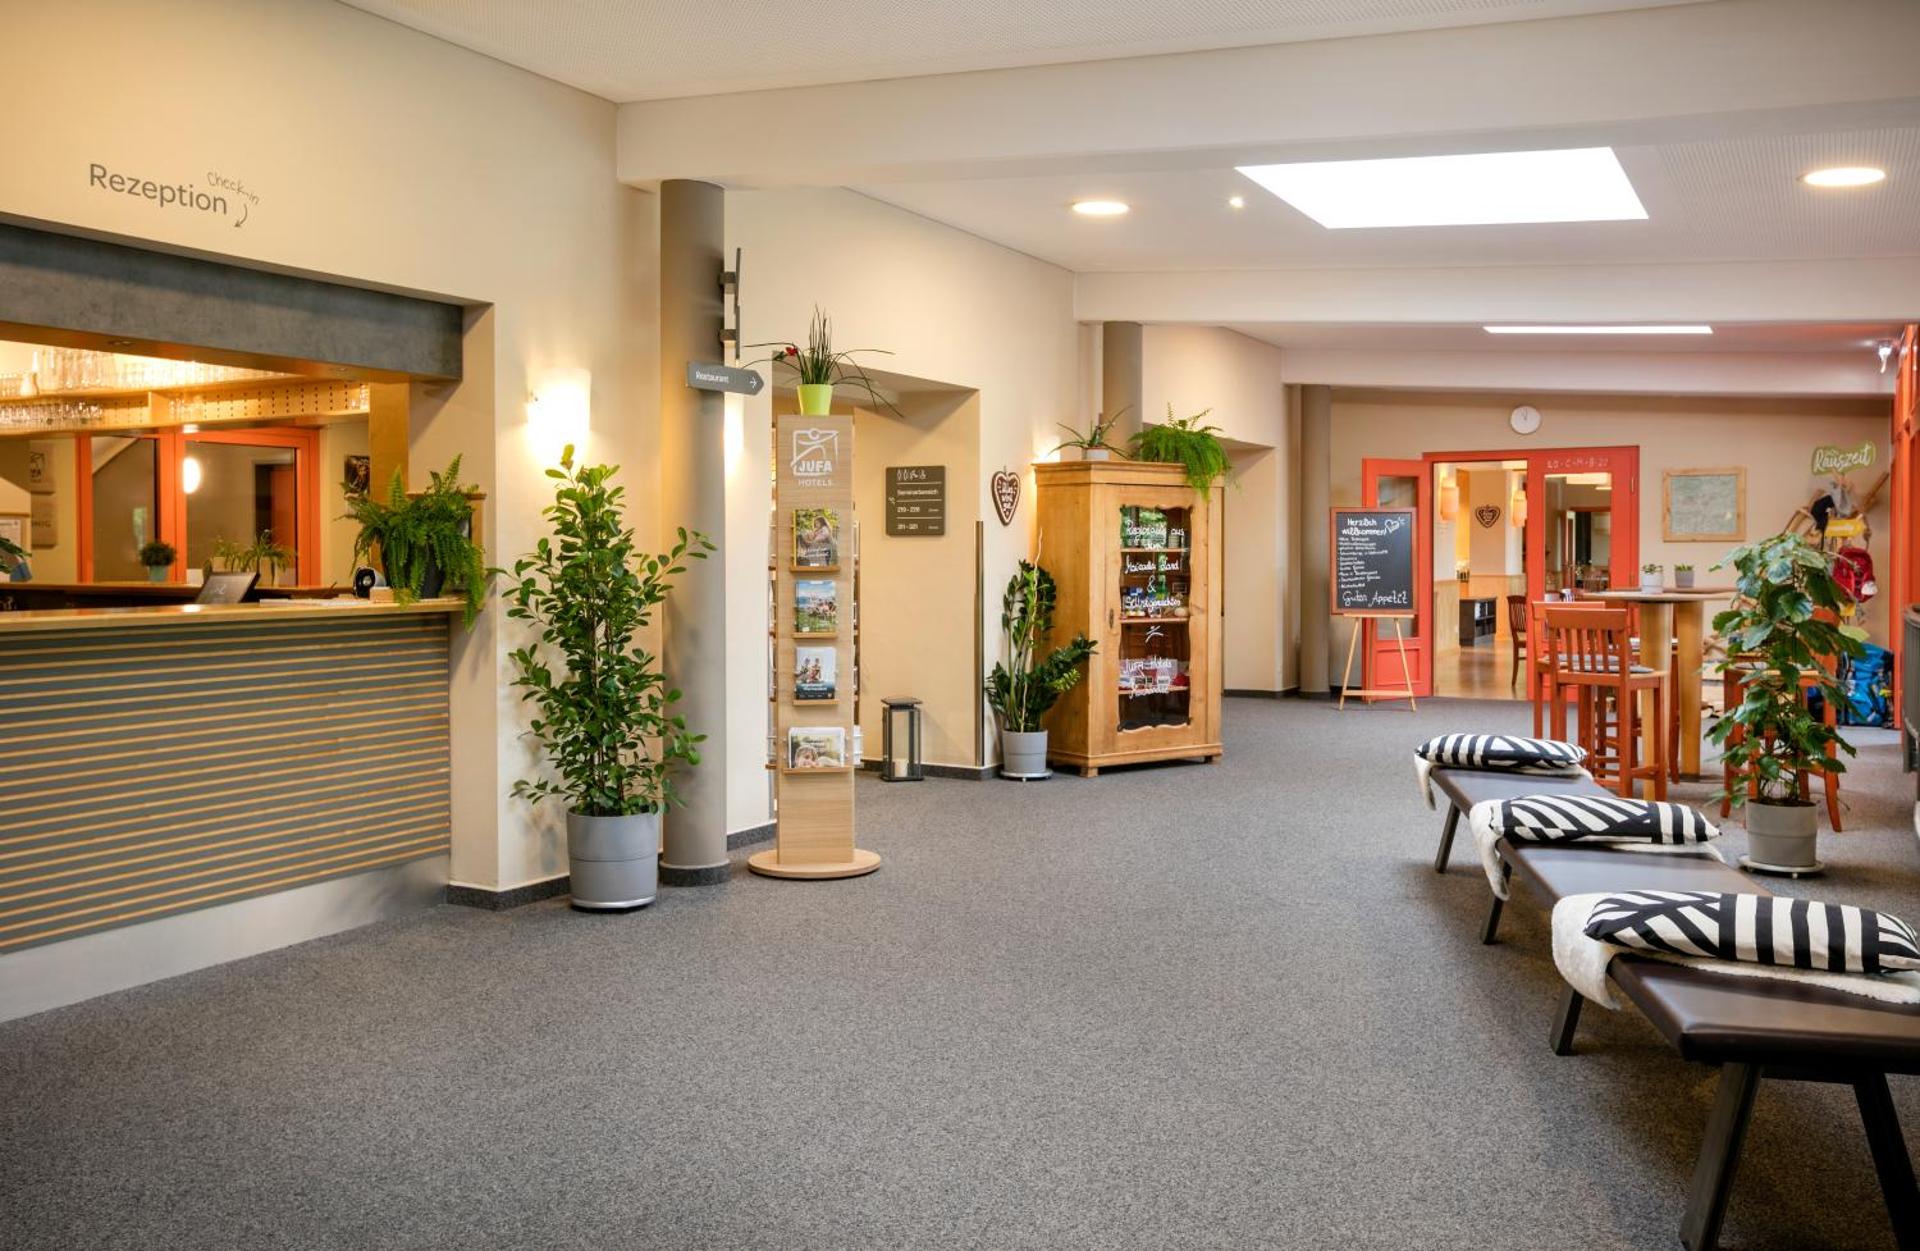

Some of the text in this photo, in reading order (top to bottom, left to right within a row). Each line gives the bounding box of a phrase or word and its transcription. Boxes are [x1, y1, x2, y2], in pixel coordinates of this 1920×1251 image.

[90, 163, 227, 215] Rezeption
[799, 460, 832, 472] JUFA
[799, 480, 832, 489] HOTELS
[1347, 517, 1377, 527] Herzlich
[1171, 528, 1185, 536] aus
[1342, 590, 1408, 607] Guten Appetit
